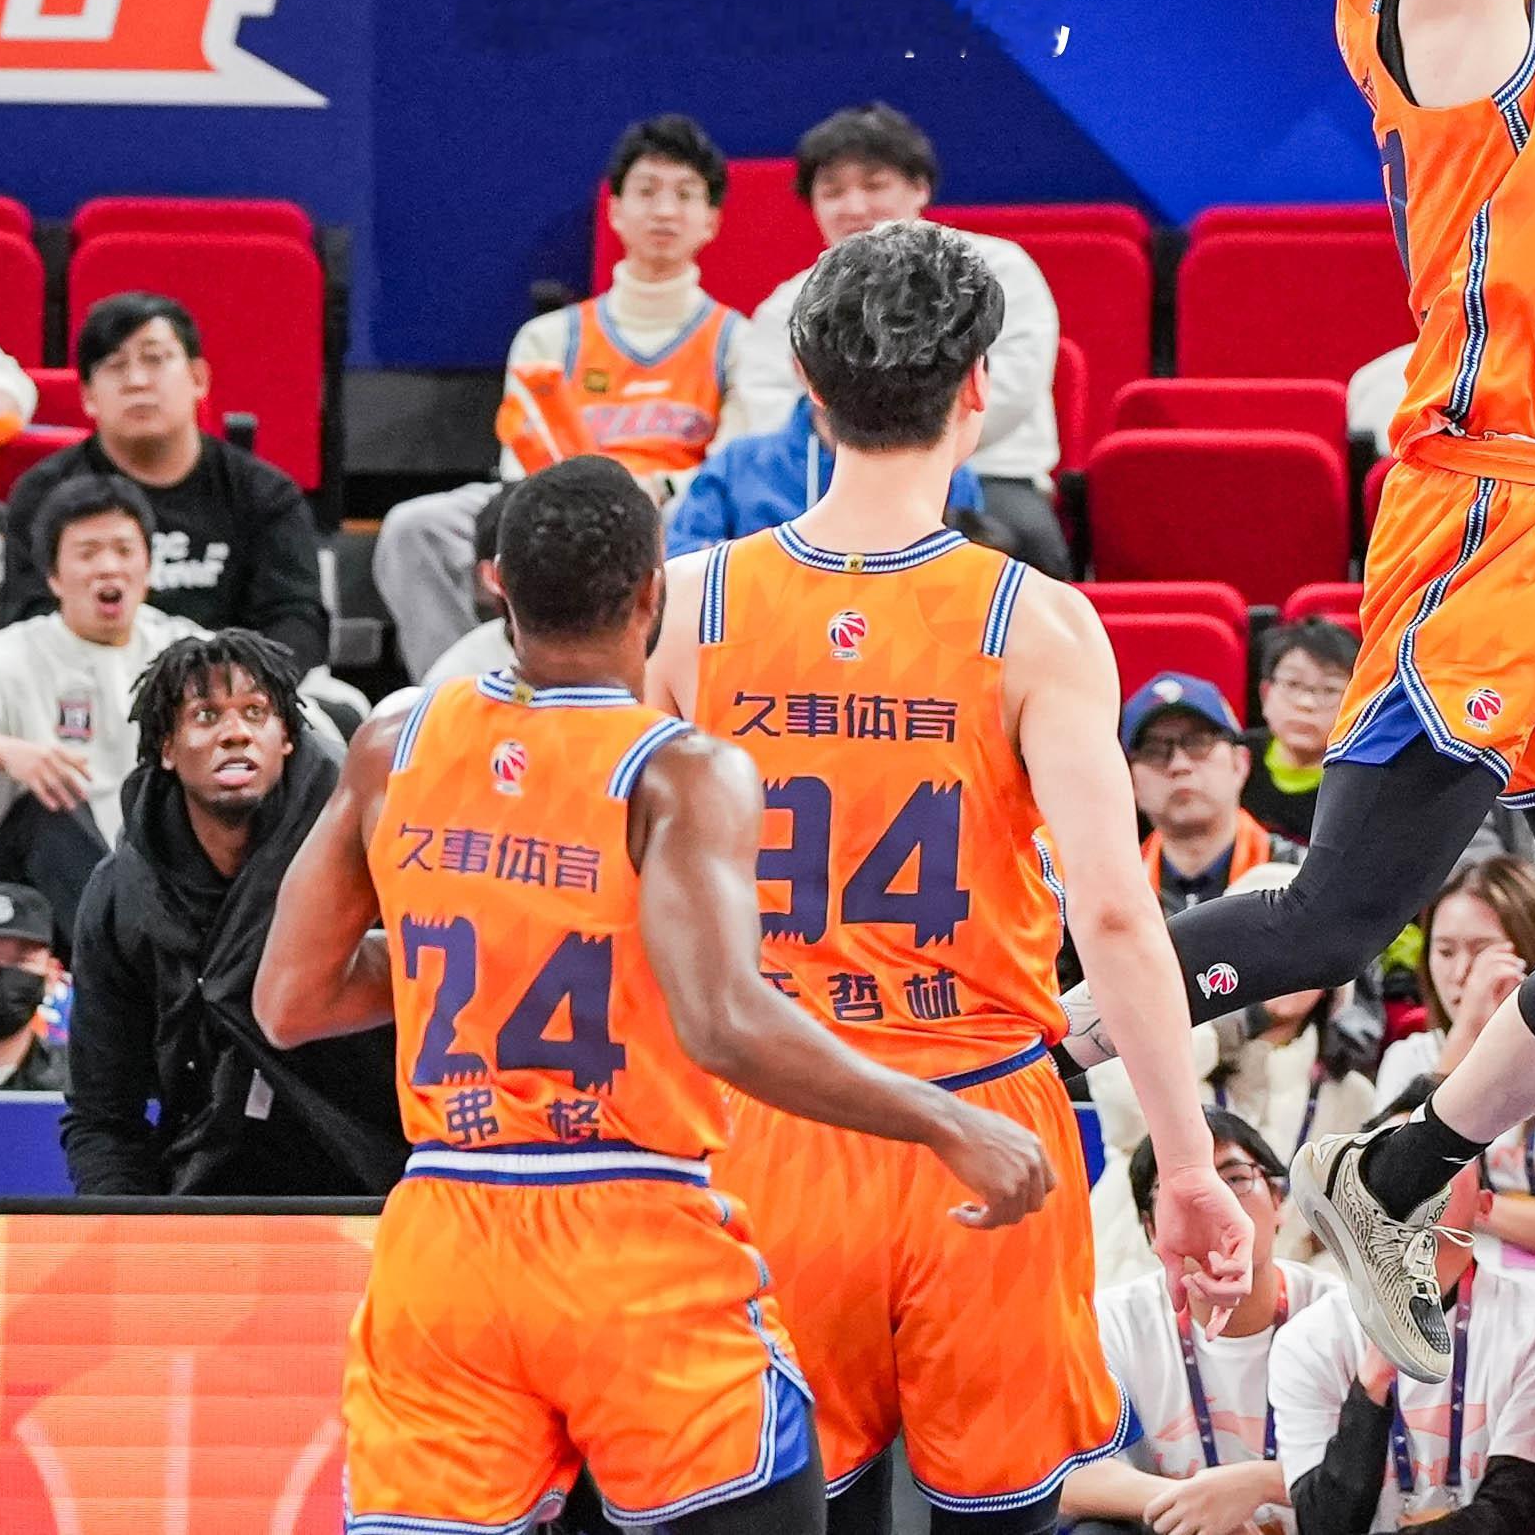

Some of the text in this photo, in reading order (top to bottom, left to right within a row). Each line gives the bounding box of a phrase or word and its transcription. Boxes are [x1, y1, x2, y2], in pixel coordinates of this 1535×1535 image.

[732, 691, 958, 742] 久事体育
[396, 822, 600, 893] 久事体育
[756, 776, 969, 948] 34
[401, 911, 626, 1095] 24
